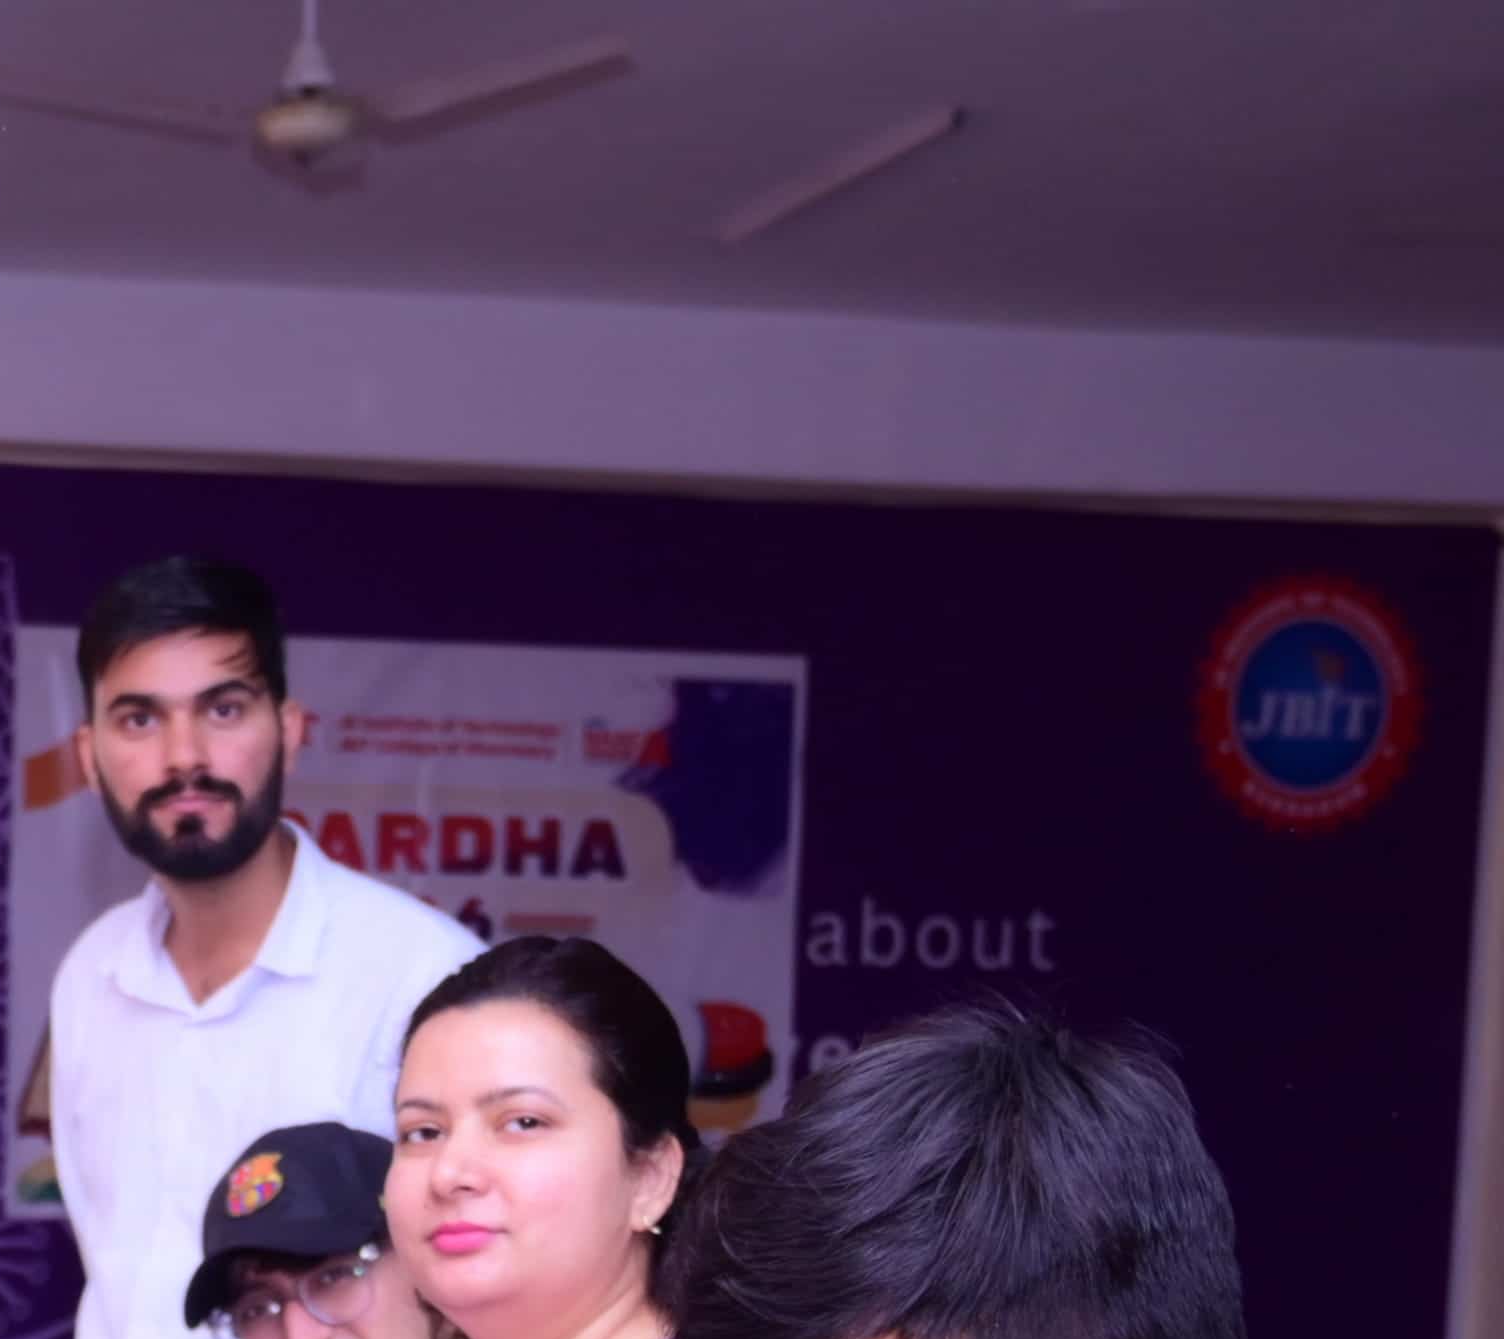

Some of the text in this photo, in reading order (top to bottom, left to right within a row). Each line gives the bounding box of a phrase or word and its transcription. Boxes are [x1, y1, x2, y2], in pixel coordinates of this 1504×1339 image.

[1241, 683, 1377, 740] JBIT
[281, 811, 627, 880] ARDHA
[805, 894, 1056, 972] about
